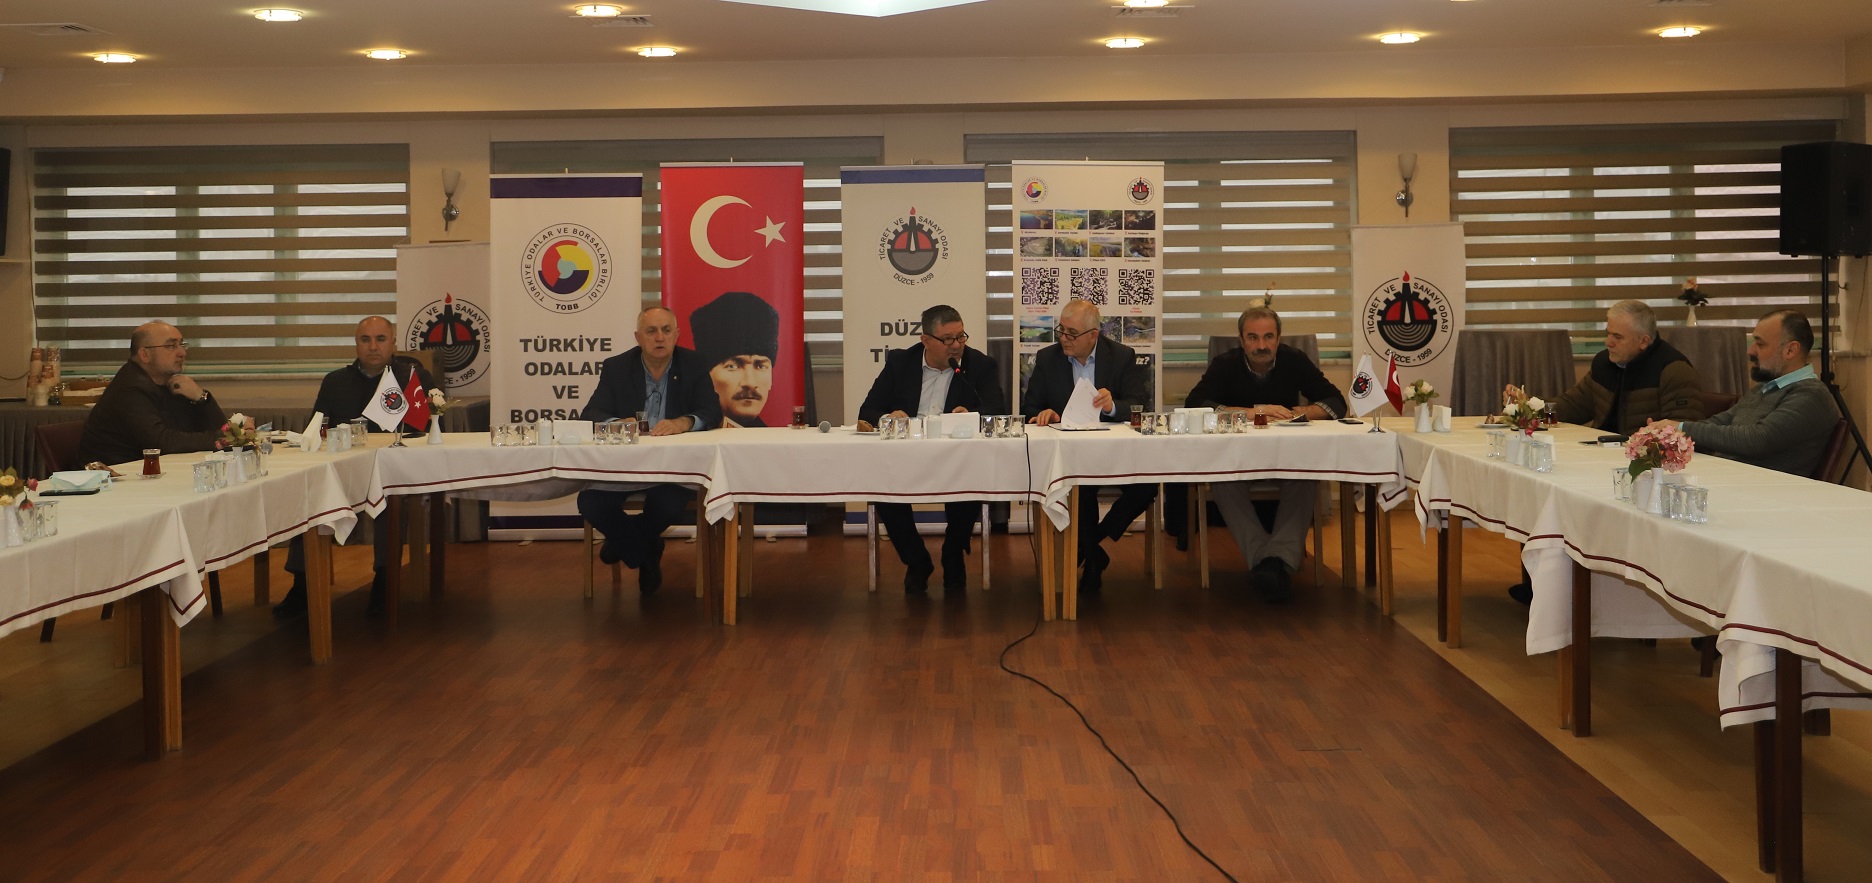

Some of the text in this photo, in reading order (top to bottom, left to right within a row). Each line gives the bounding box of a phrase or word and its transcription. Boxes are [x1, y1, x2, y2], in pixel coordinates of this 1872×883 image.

[526, 230, 554, 260] ODALAR
[572, 228, 608, 265] BORSALAR
[878, 216, 949, 260] TİCARET VE SANAYİ ODASI
[525, 264, 545, 302] TÜRKİYE
[893, 273, 916, 285] DÜZCE
[920, 272, 934, 284] 1959
[556, 303, 579, 311] TOBB
[1367, 282, 1449, 335] TİCARET VE SANAYİ ODASI
[409, 304, 491, 353] İCARET VE SANAYİ ODASI
[880, 319, 923, 336] DÜZ
[519, 335, 612, 352] TÜRKİYE
[1417, 348, 1433, 361] 1959
[460, 368, 477, 382] 1959
[524, 361, 604, 376] ODALAR
[552, 385, 580, 399] VE
[510, 409, 581, 423] BORSA
